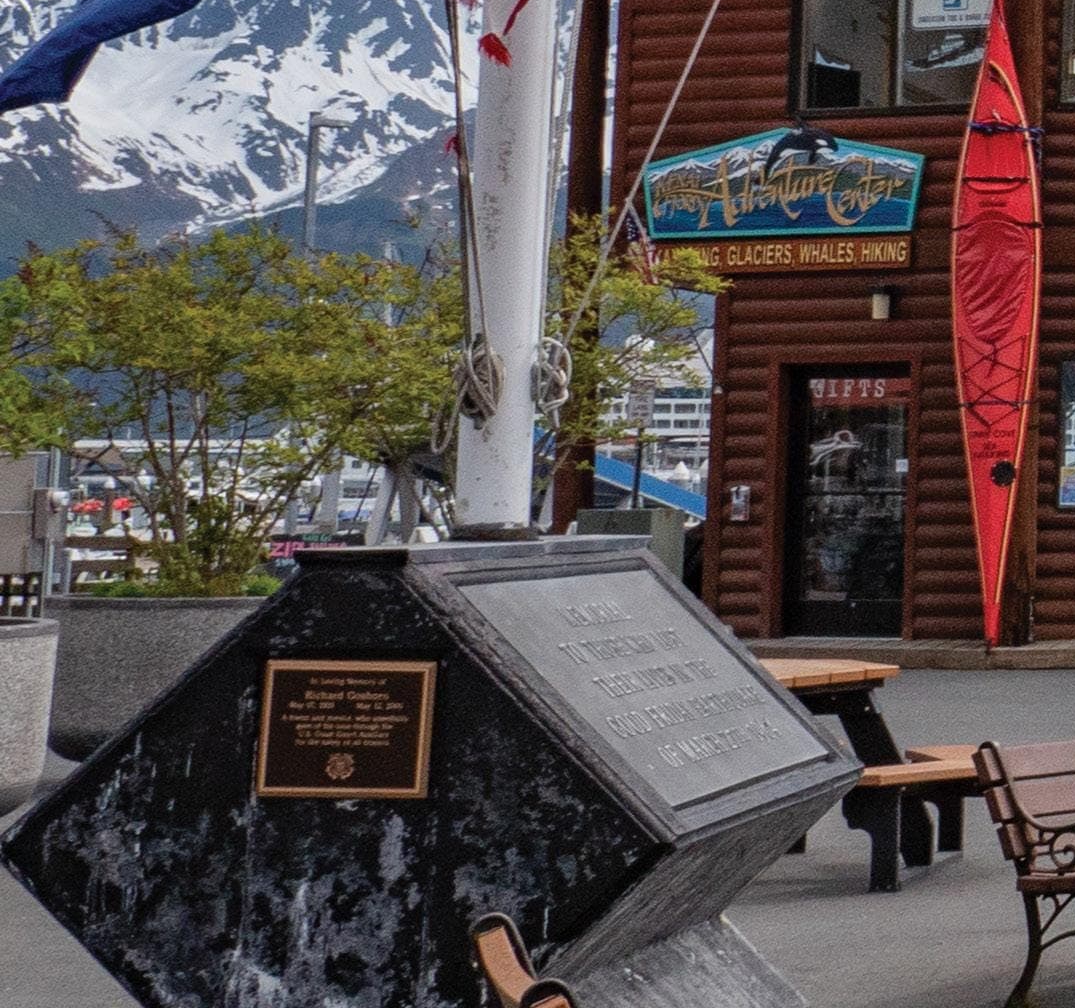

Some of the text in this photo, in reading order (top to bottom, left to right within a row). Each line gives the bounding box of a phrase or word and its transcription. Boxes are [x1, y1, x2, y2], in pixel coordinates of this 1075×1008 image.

[827, 155, 905, 227] Center
[861, 241, 907, 263] HIKING
[809, 378, 887, 398] GIFTS
[558, 642, 589, 664] TO
[605, 710, 652, 739] GOOD
[657, 744, 686, 767] OF
